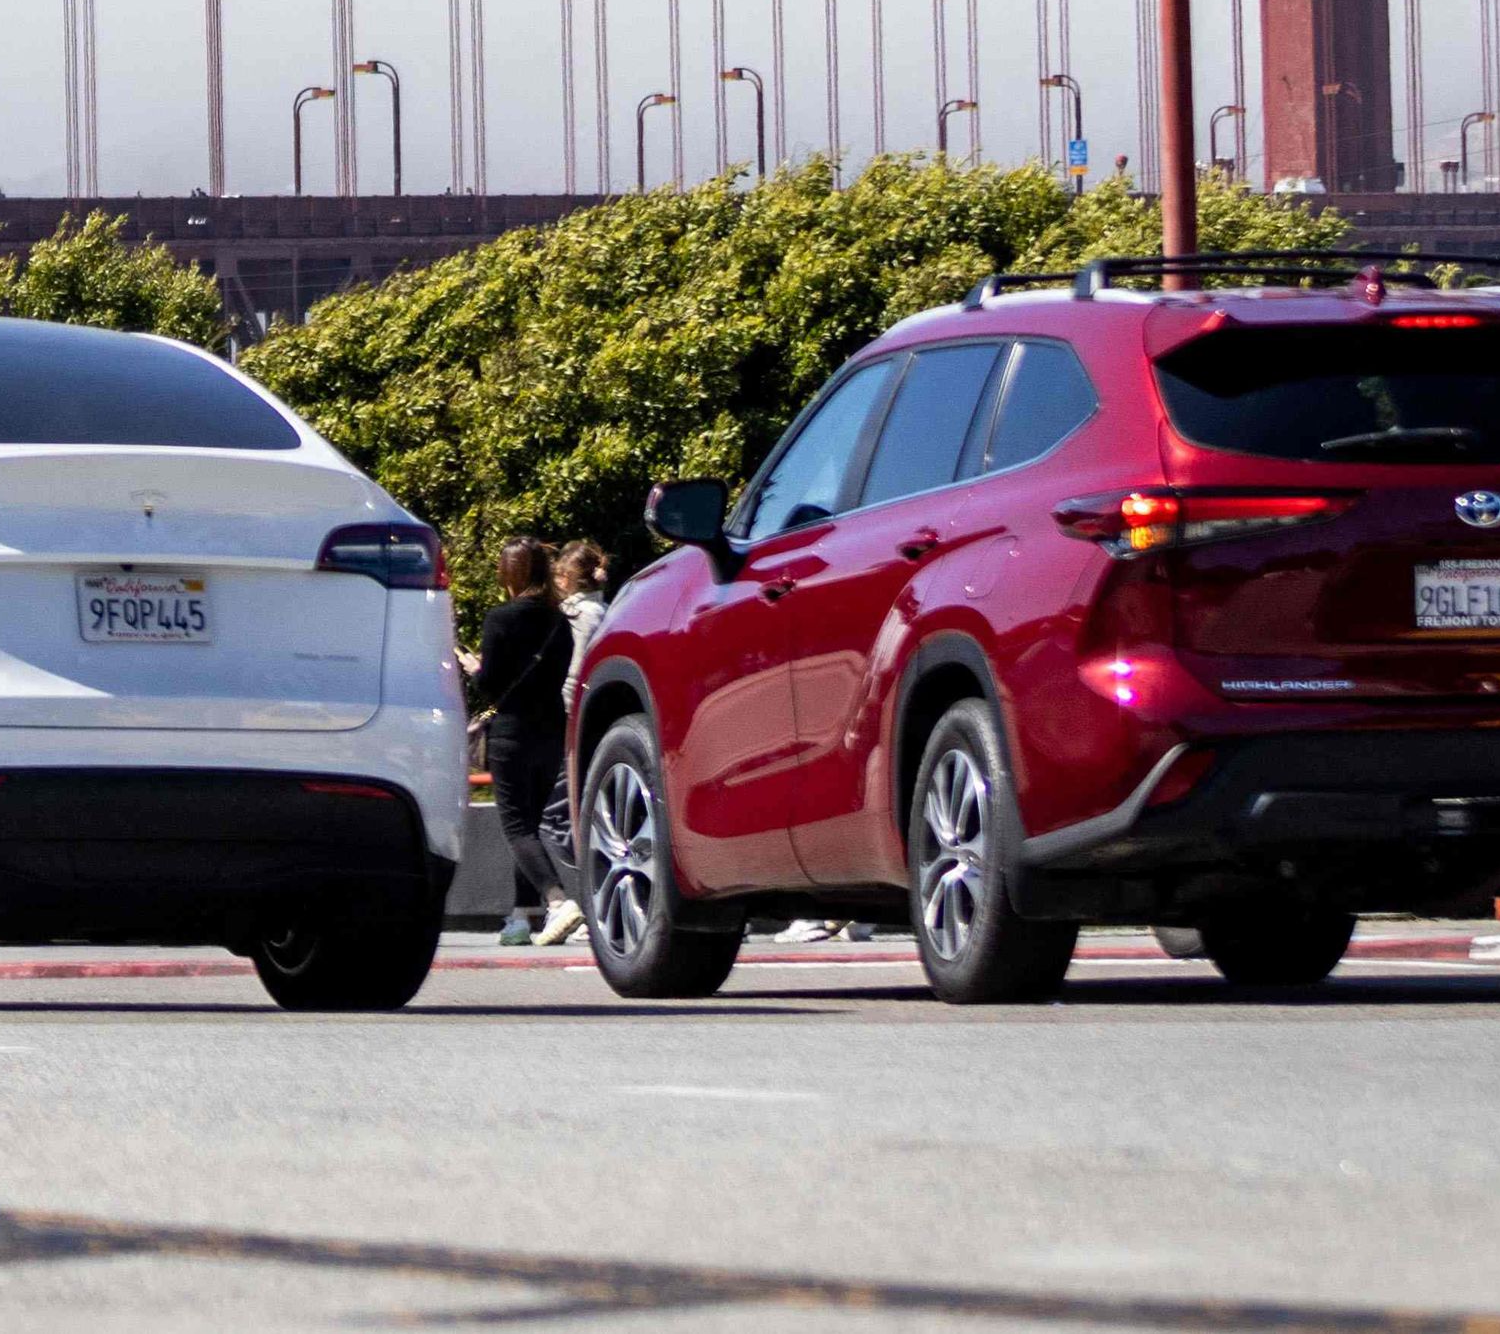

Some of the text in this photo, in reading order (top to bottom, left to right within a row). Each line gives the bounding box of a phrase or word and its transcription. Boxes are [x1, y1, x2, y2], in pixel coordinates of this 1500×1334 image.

[90, 598, 205, 631] 9FQP445
[1416, 616, 1478, 626] FREMONT
[1221, 680, 1354, 692] HIGHLANDER
